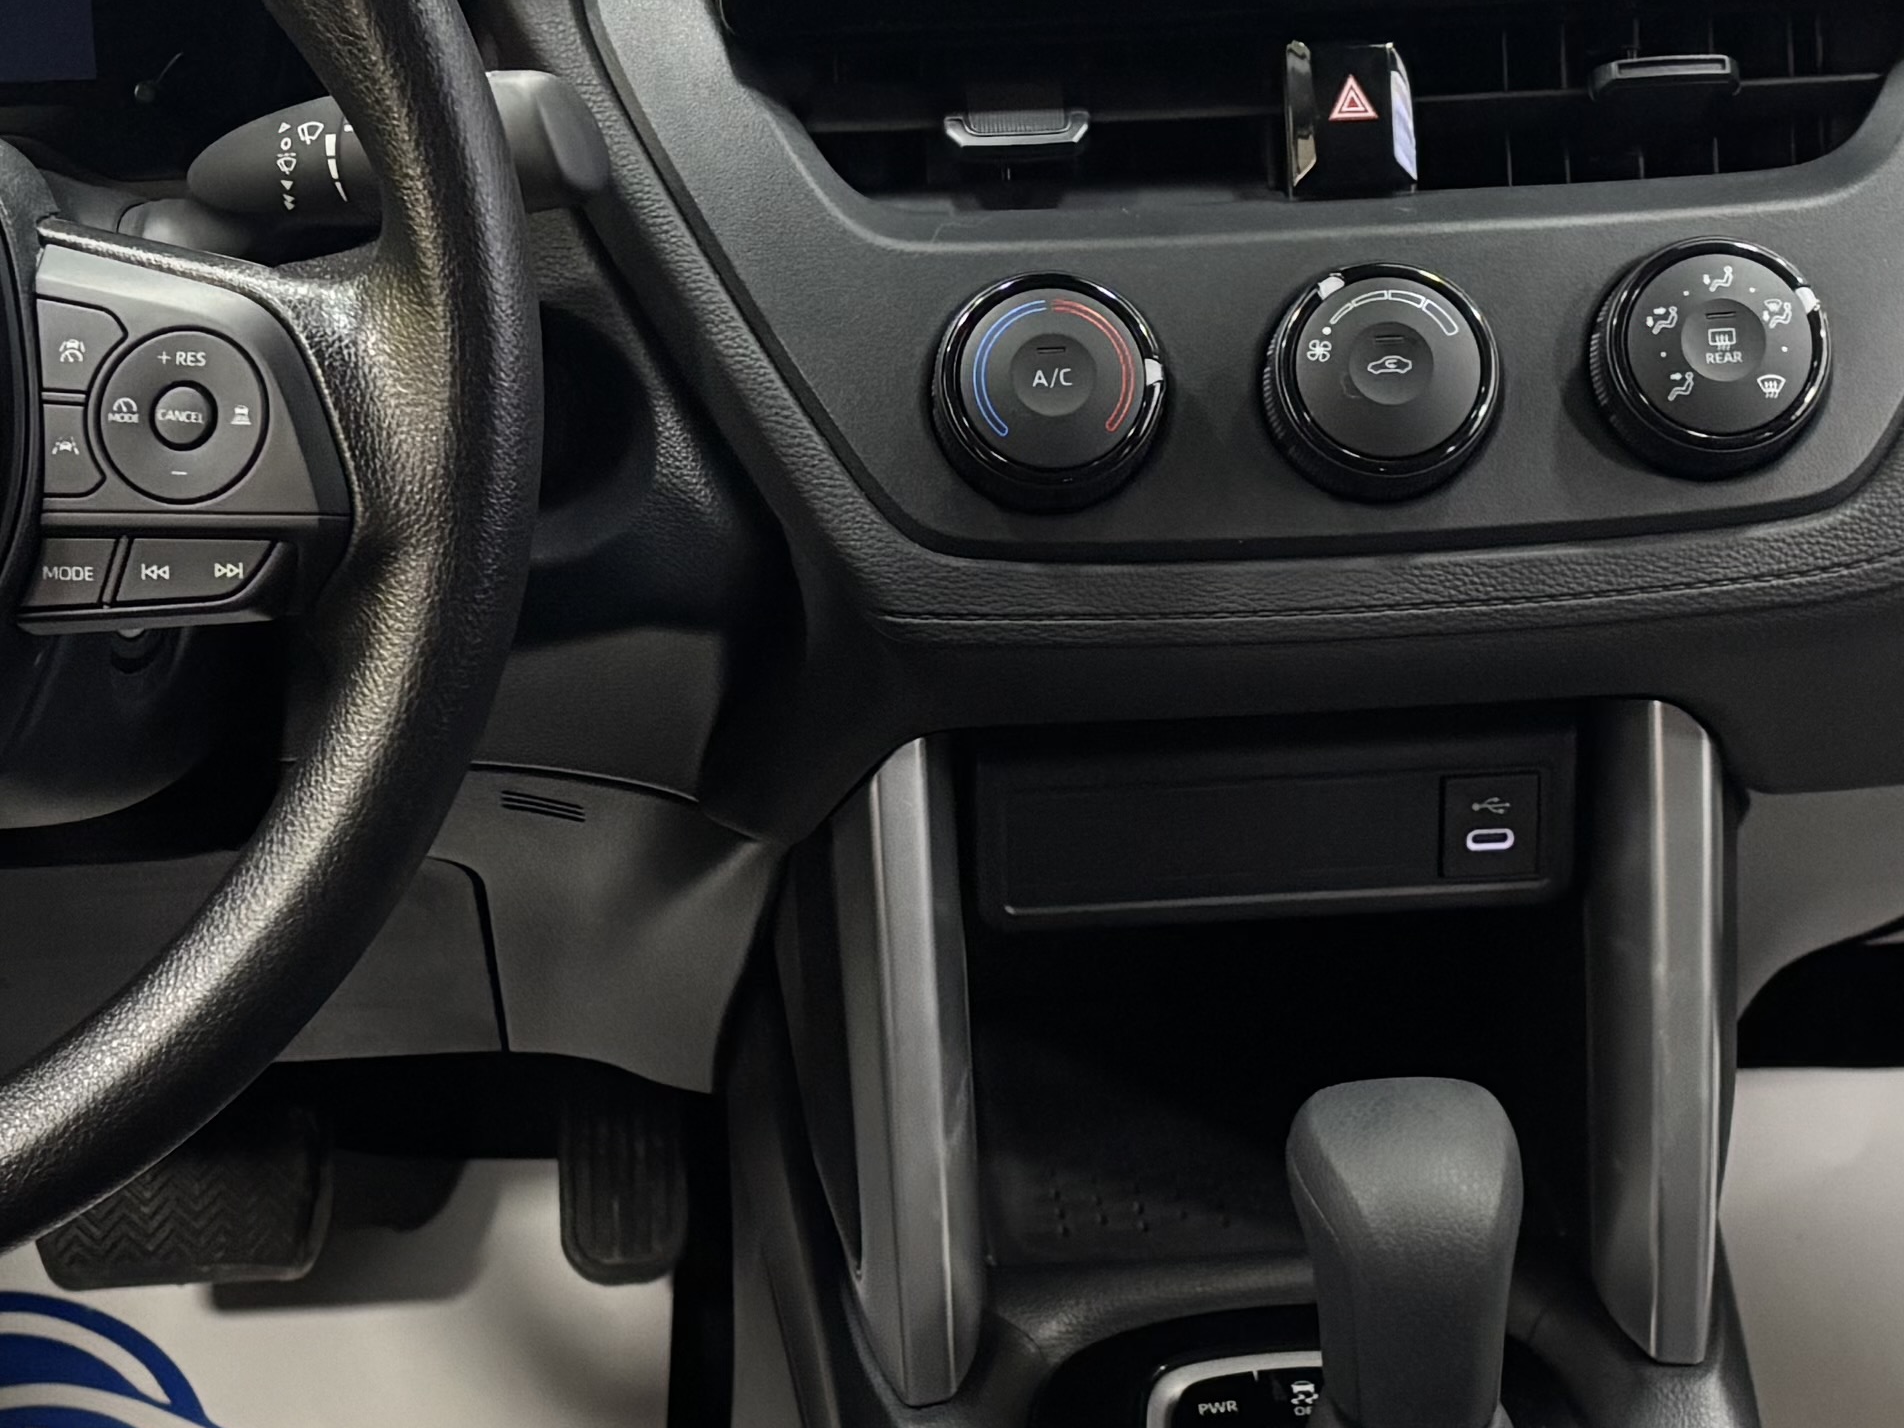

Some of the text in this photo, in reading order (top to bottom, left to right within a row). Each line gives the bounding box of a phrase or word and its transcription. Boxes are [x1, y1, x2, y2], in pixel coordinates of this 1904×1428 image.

[175, 351, 206, 367] RES
[1705, 351, 1744, 364] REAR
[1032, 367, 1073, 389] A/C
[108, 412, 139, 424] MODE
[156, 409, 204, 425] CANCEL
[42, 565, 94, 582] MODE
[1197, 1400, 1239, 1416] PWR
